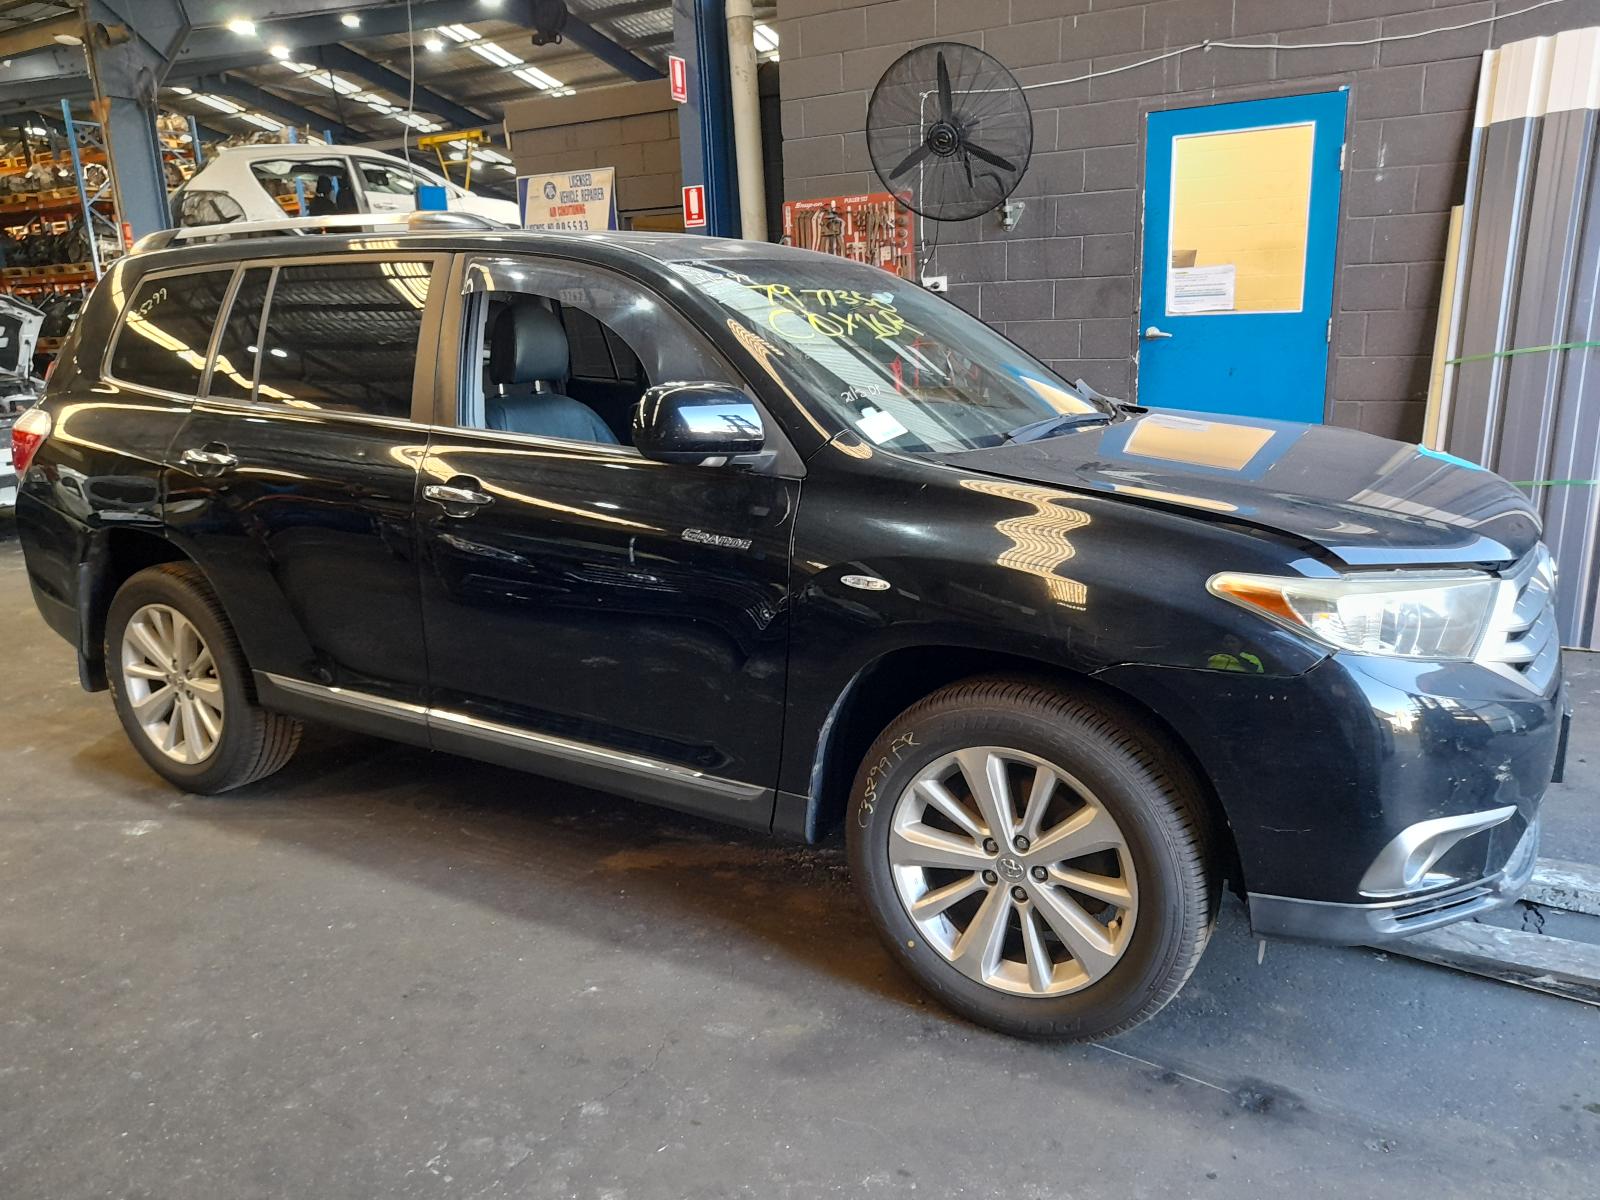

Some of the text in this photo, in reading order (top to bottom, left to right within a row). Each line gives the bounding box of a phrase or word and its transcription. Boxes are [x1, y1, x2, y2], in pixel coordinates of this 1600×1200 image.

[568, 173, 592, 188] LICENSED
[560, 187, 604, 204] VEHICLE REPAIRER
